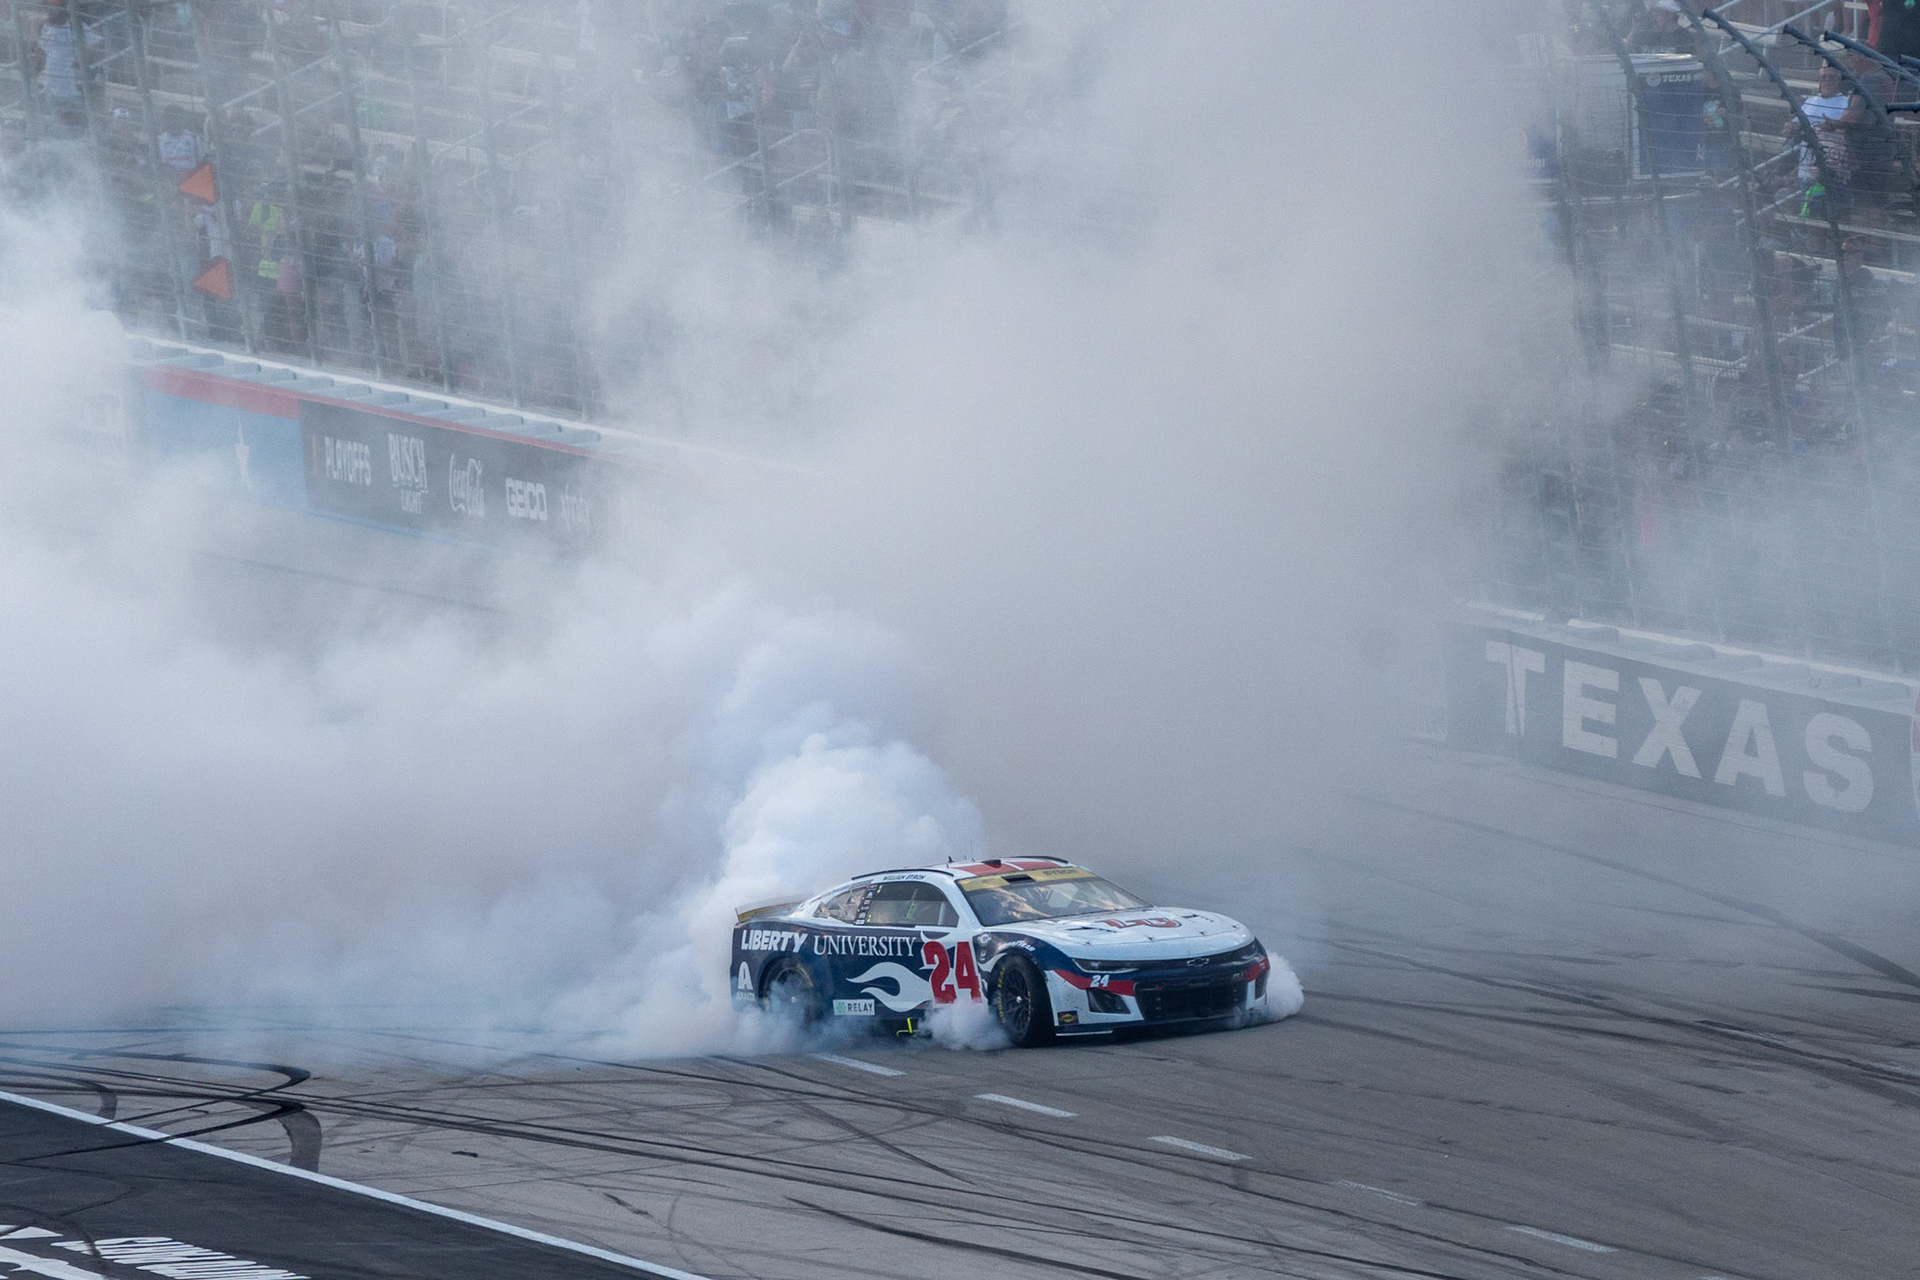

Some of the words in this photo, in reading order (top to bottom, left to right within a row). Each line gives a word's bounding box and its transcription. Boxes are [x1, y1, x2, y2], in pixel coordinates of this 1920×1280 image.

[1662, 73, 1692, 83] TEXAS
[324, 436, 372, 486] PLAYOFFS
[387, 432, 428, 491] BUSCH
[504, 477, 548, 522] GEICO
[1485, 640, 1875, 813] TEXAS
[741, 929, 809, 953] LIBERTY
[813, 935, 917, 957] UNIVERSITY
[922, 940, 983, 1005] 24
[1090, 974, 1111, 988] 24
[847, 1002, 874, 1014] RELAY
